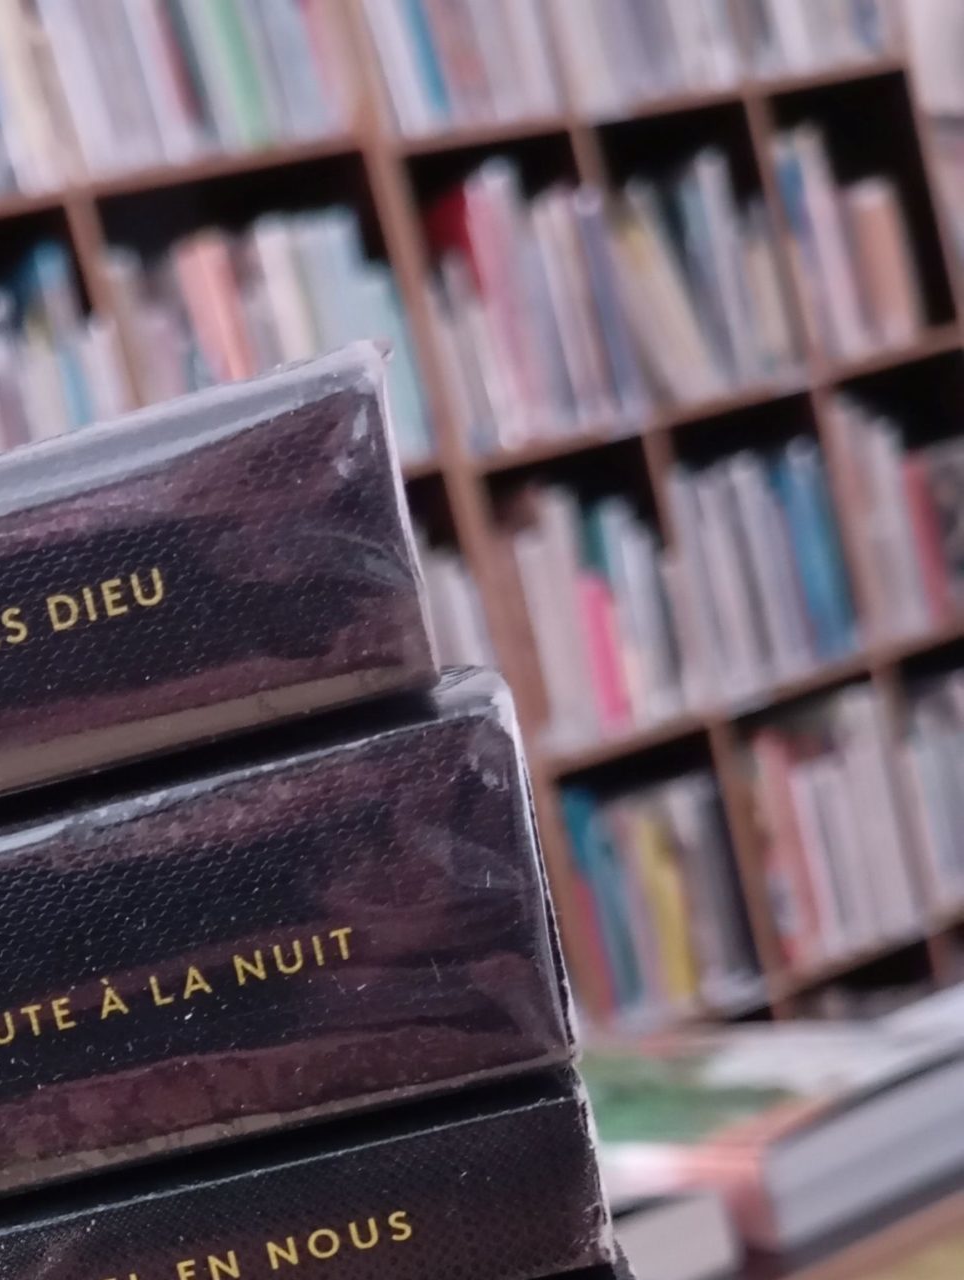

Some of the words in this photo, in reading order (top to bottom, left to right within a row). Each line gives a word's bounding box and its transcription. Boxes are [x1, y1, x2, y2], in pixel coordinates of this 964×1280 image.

[46, 568, 165, 632] DIEU
[100, 977, 131, 1020] À
[150, 966, 213, 1007] LA
[233, 927, 354, 986] NUIT
[264, 1210, 415, 1270] NOUS
